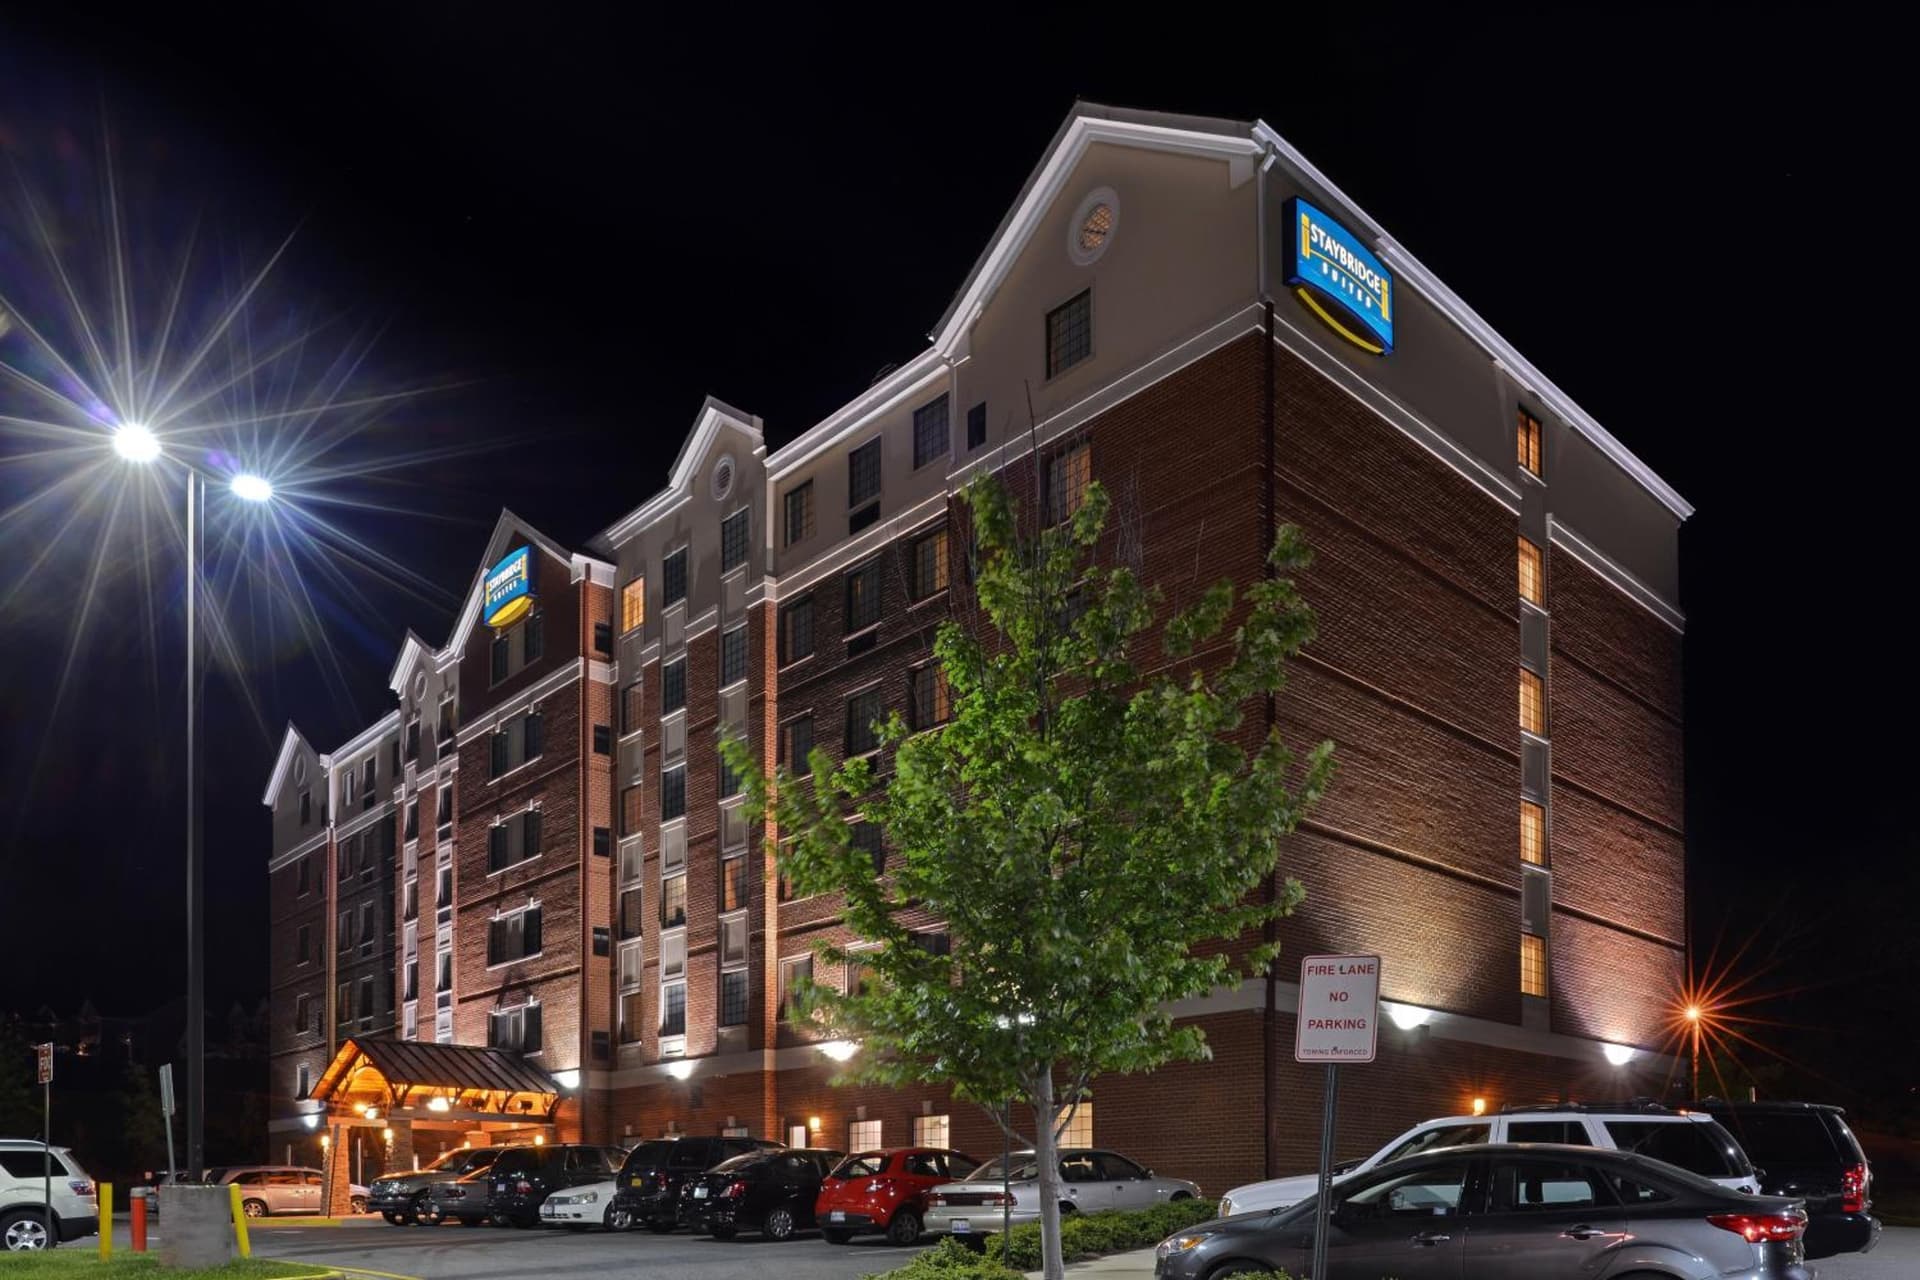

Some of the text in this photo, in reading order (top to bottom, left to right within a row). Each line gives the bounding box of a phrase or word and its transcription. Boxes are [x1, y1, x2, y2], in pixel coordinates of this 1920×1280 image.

[1310, 223, 1382, 294] STAYBRIDGE
[1322, 261, 1372, 309] SUITES
[1307, 964, 1376, 976] FIRE LANE
[1329, 991, 1350, 1002] NO
[1308, 1018, 1367, 1030] PARKING
